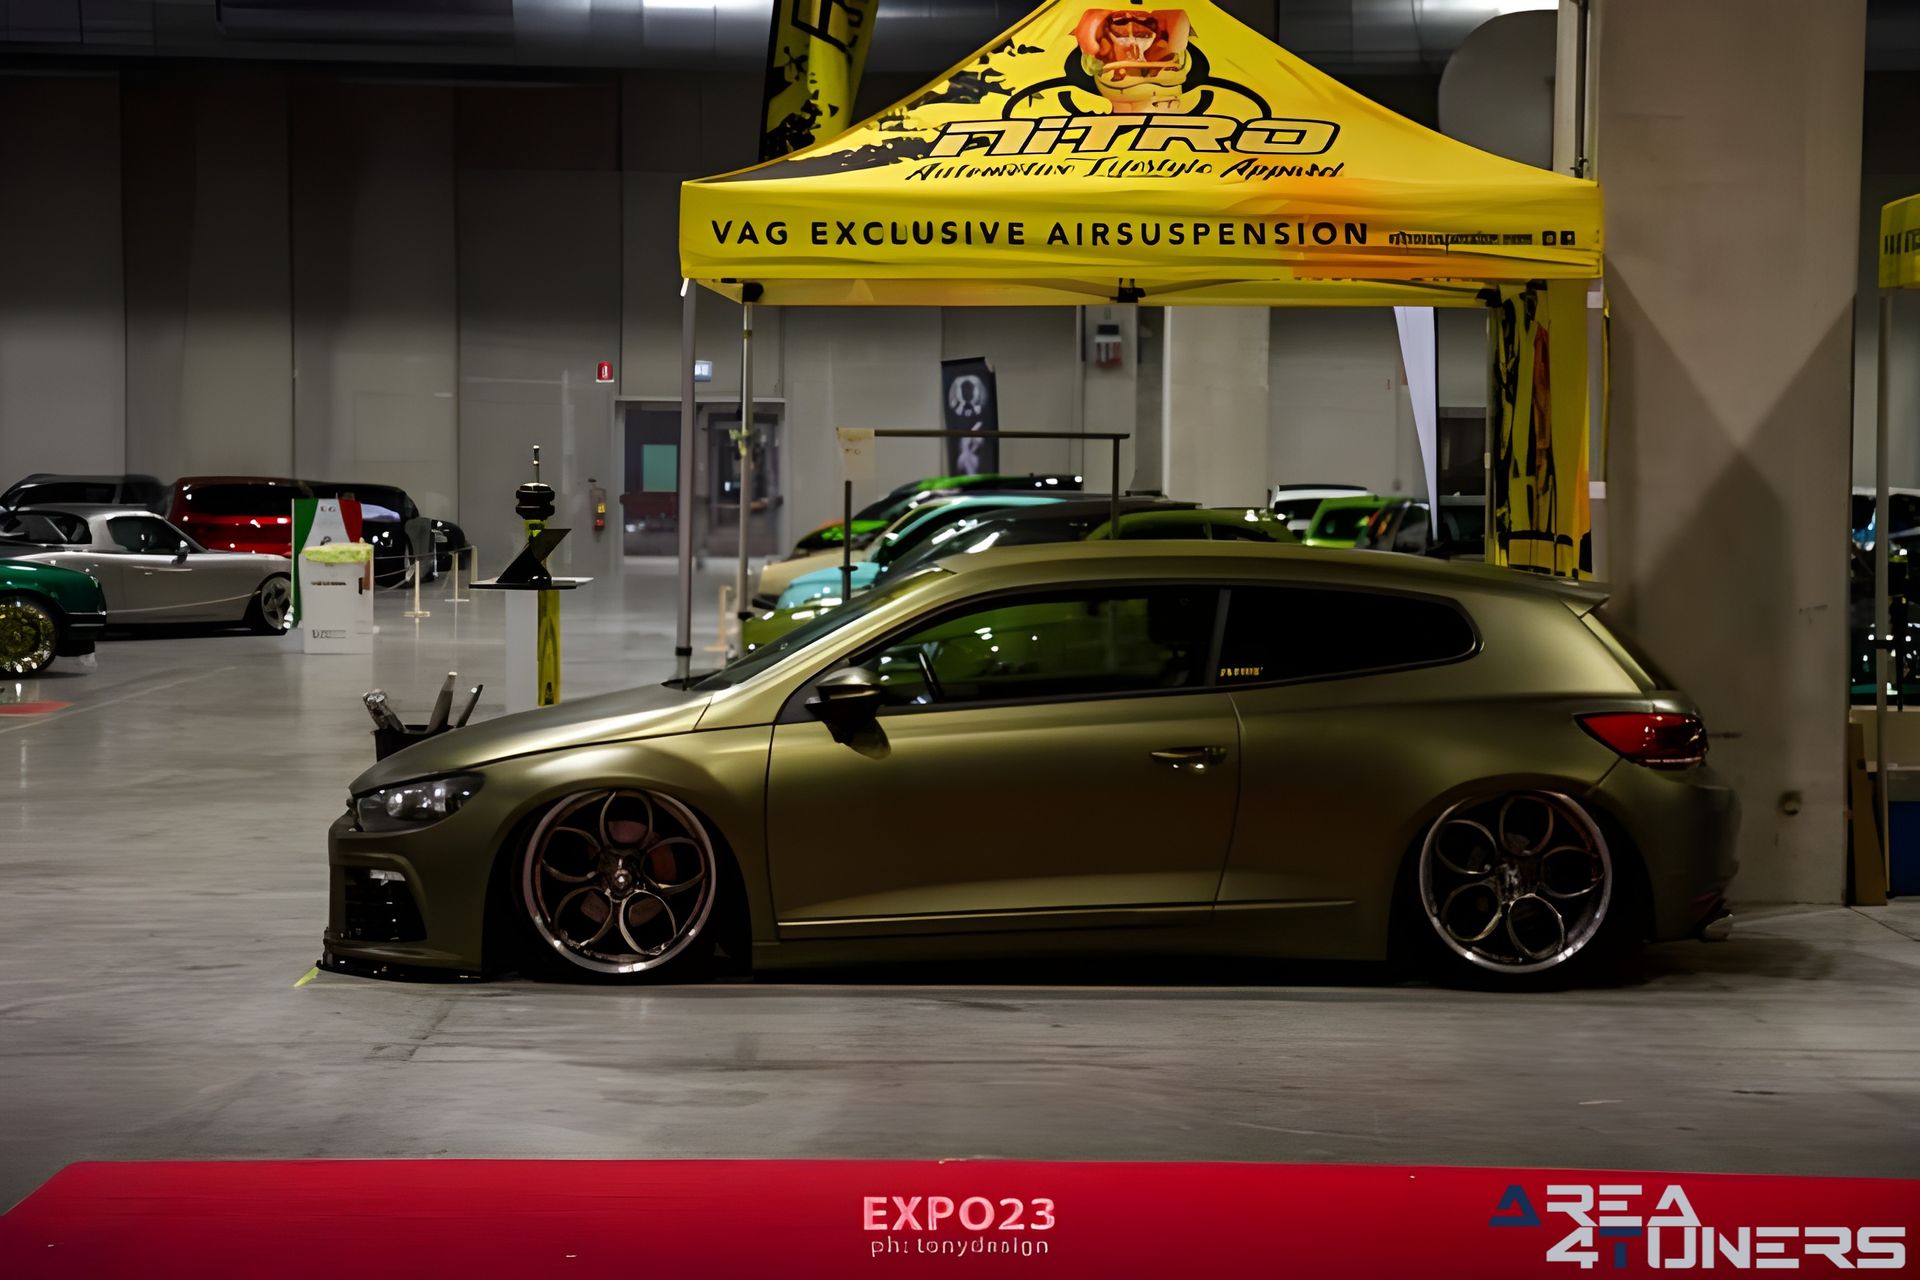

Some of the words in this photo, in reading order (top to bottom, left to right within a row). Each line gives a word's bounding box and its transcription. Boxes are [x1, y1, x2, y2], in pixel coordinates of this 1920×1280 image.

[711, 220, 788, 246] VAG
[811, 221, 1025, 246] EXCLUSIVE
[1047, 222, 1367, 246] AIRSUSPENSION
